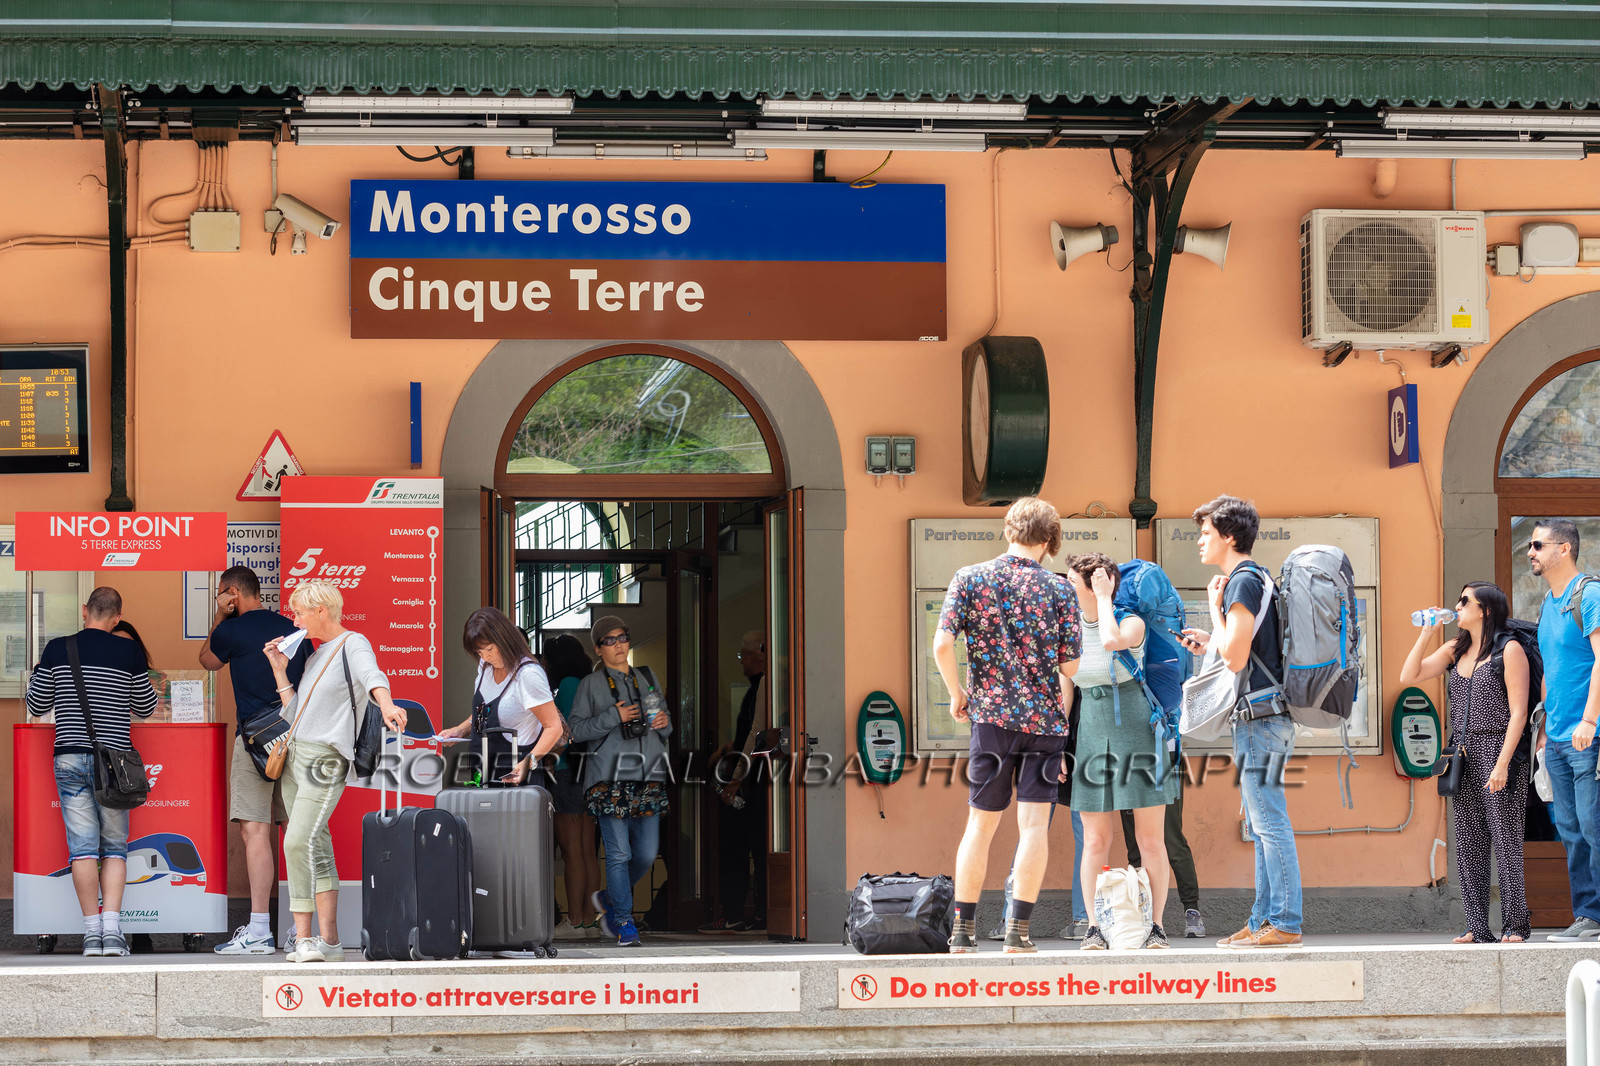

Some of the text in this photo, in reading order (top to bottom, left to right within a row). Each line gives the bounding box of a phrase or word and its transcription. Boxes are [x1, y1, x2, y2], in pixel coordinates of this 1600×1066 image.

[369, 190, 692, 235] Monterosso
[368, 266, 706, 323] Cinque Terre
[50, 516, 194, 537] INFO POINT
[267, 530, 278, 538] DI
[924, 528, 995, 541] Partenze
[81, 540, 162, 550] 5 TERRE EXPRESS
[288, 548, 366, 576] 5 terre
[392, 598, 424, 606] Corniglia
[379, 645, 424, 653] Riomaggiore
[318, 982, 700, 1009] Vietato attraversare i binari
[890, 970, 1277, 1000] Do not cross the railway lines
